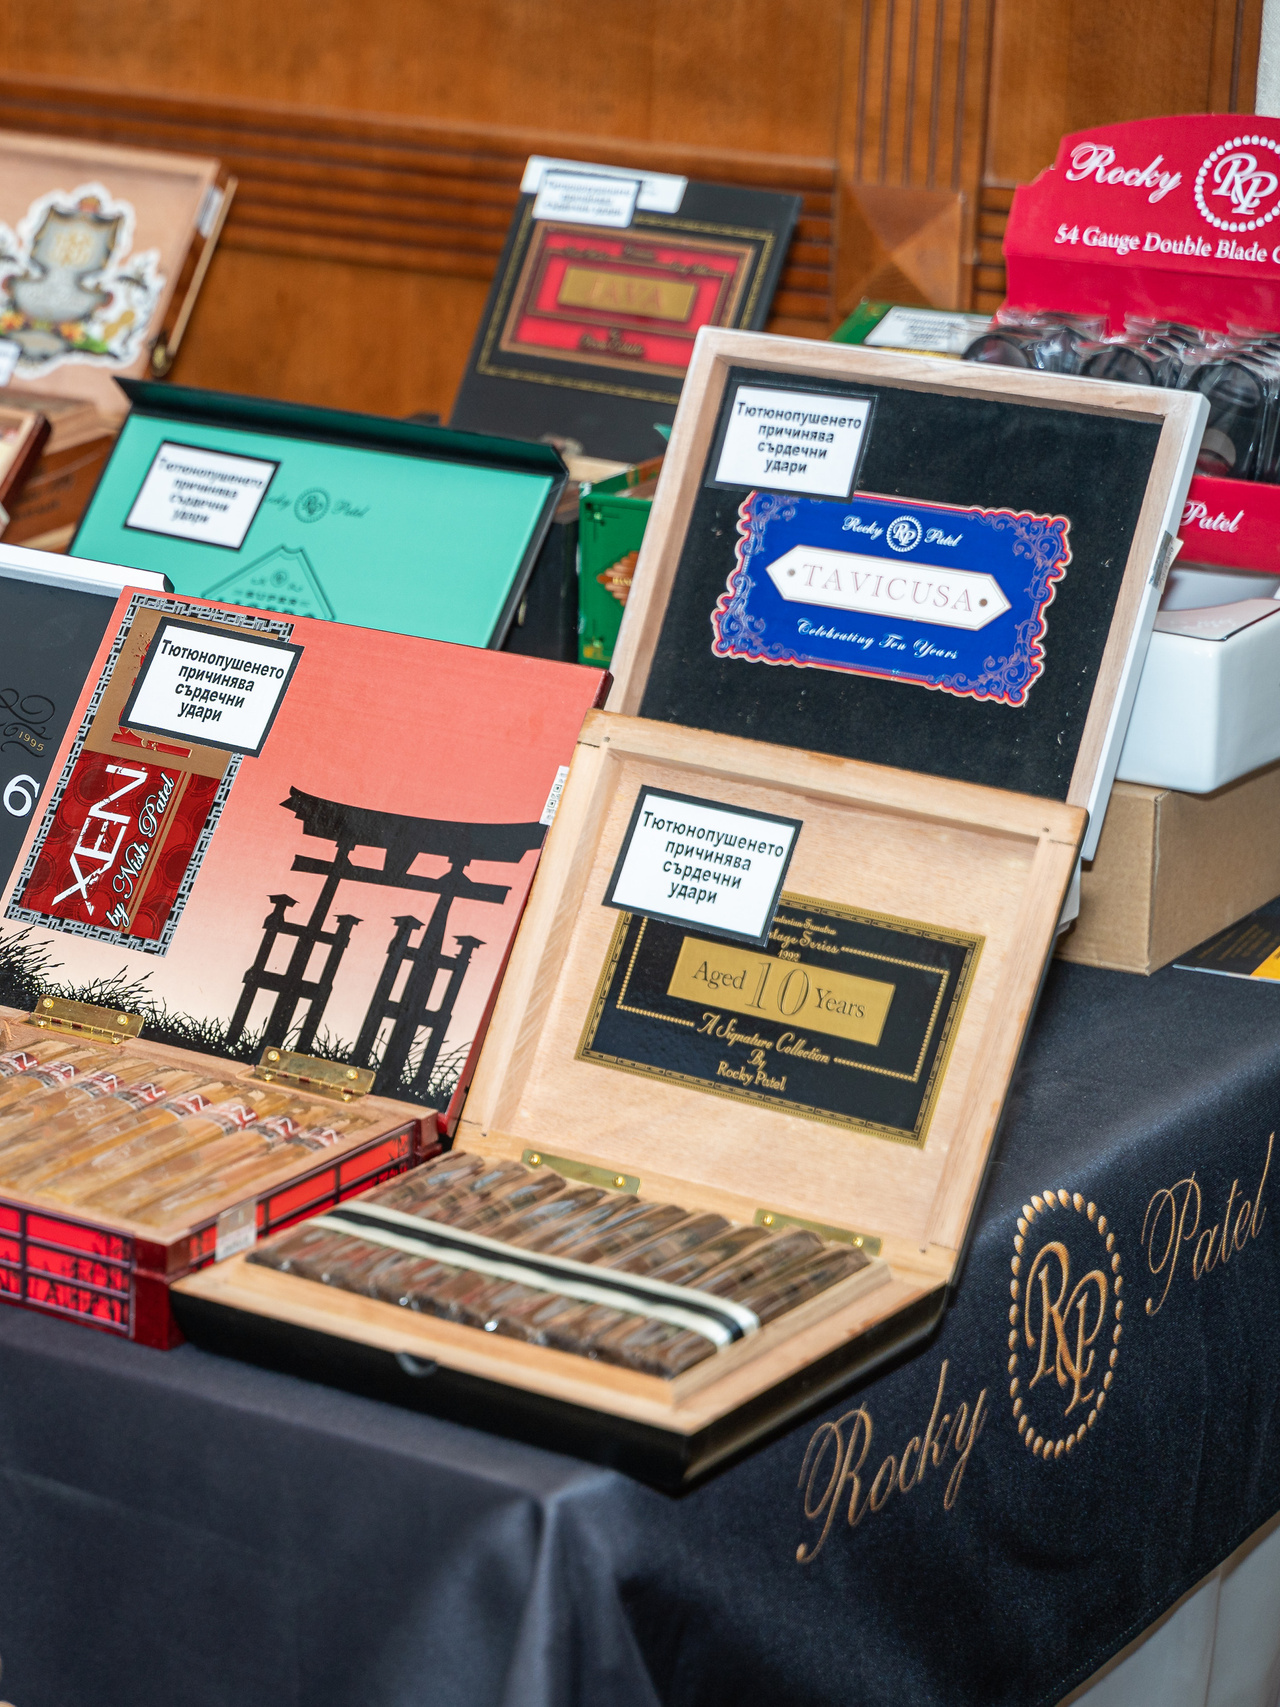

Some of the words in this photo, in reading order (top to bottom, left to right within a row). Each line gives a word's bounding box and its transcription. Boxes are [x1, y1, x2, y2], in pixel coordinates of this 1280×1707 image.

[1065, 141, 1182, 203] Rocky
[1054, 223, 1080, 244] 54
[1082, 226, 1141, 255] Gauge
[1143, 231, 1212, 257] Double
[1215, 239, 1268, 262] Blade
[737, 401, 862, 429] Тютюнопушенето
[758, 424, 835, 444] причинява
[757, 441, 828, 460] сърдечни
[763, 459, 807, 476] удари
[842, 514, 884, 540] Rocky
[924, 527, 964, 547] Patel
[1180, 499, 1245, 533] Patel
[803, 563, 973, 612] TAVICUSA
[797, 617, 875, 650] Celebrating
[878, 632, 907, 650] Ten
[913, 638, 958, 660] Years
[161, 639, 284, 679] Тютюнопушенето
[178, 665, 255, 692] причинява
[175, 683, 245, 708] сърдечни
[177, 702, 223, 722] удари
[17, 731, 45, 752] 1995
[2, 774, 42, 817] 6
[138, 772, 176, 838] Patel
[52, 764, 148, 916] XEN
[643, 810, 784, 858] Тютюнопушенето
[112, 840, 150, 899] Nish
[665, 840, 752, 871] причинява
[663, 860, 742, 889] сърдечни
[667, 881, 718, 905] удари
[105, 903, 131, 928] by
[778, 949, 801, 962] 1992
[799, 930, 840, 954] Series
[691, 960, 747, 990] Aged
[745, 962, 811, 1017] 10
[814, 987, 866, 1018] Years
[696, 1012, 720, 1035] A
[715, 1018, 774, 1049] Signature
[775, 1031, 831, 1065] Collection
[716, 1060, 754, 1086] Rocky
[753, 1071, 788, 1092] Patel
[747, 1049, 767, 1071] By
[796, 1359, 988, 1564] Rocky
[1140, 1131, 1275, 1316] Patel
